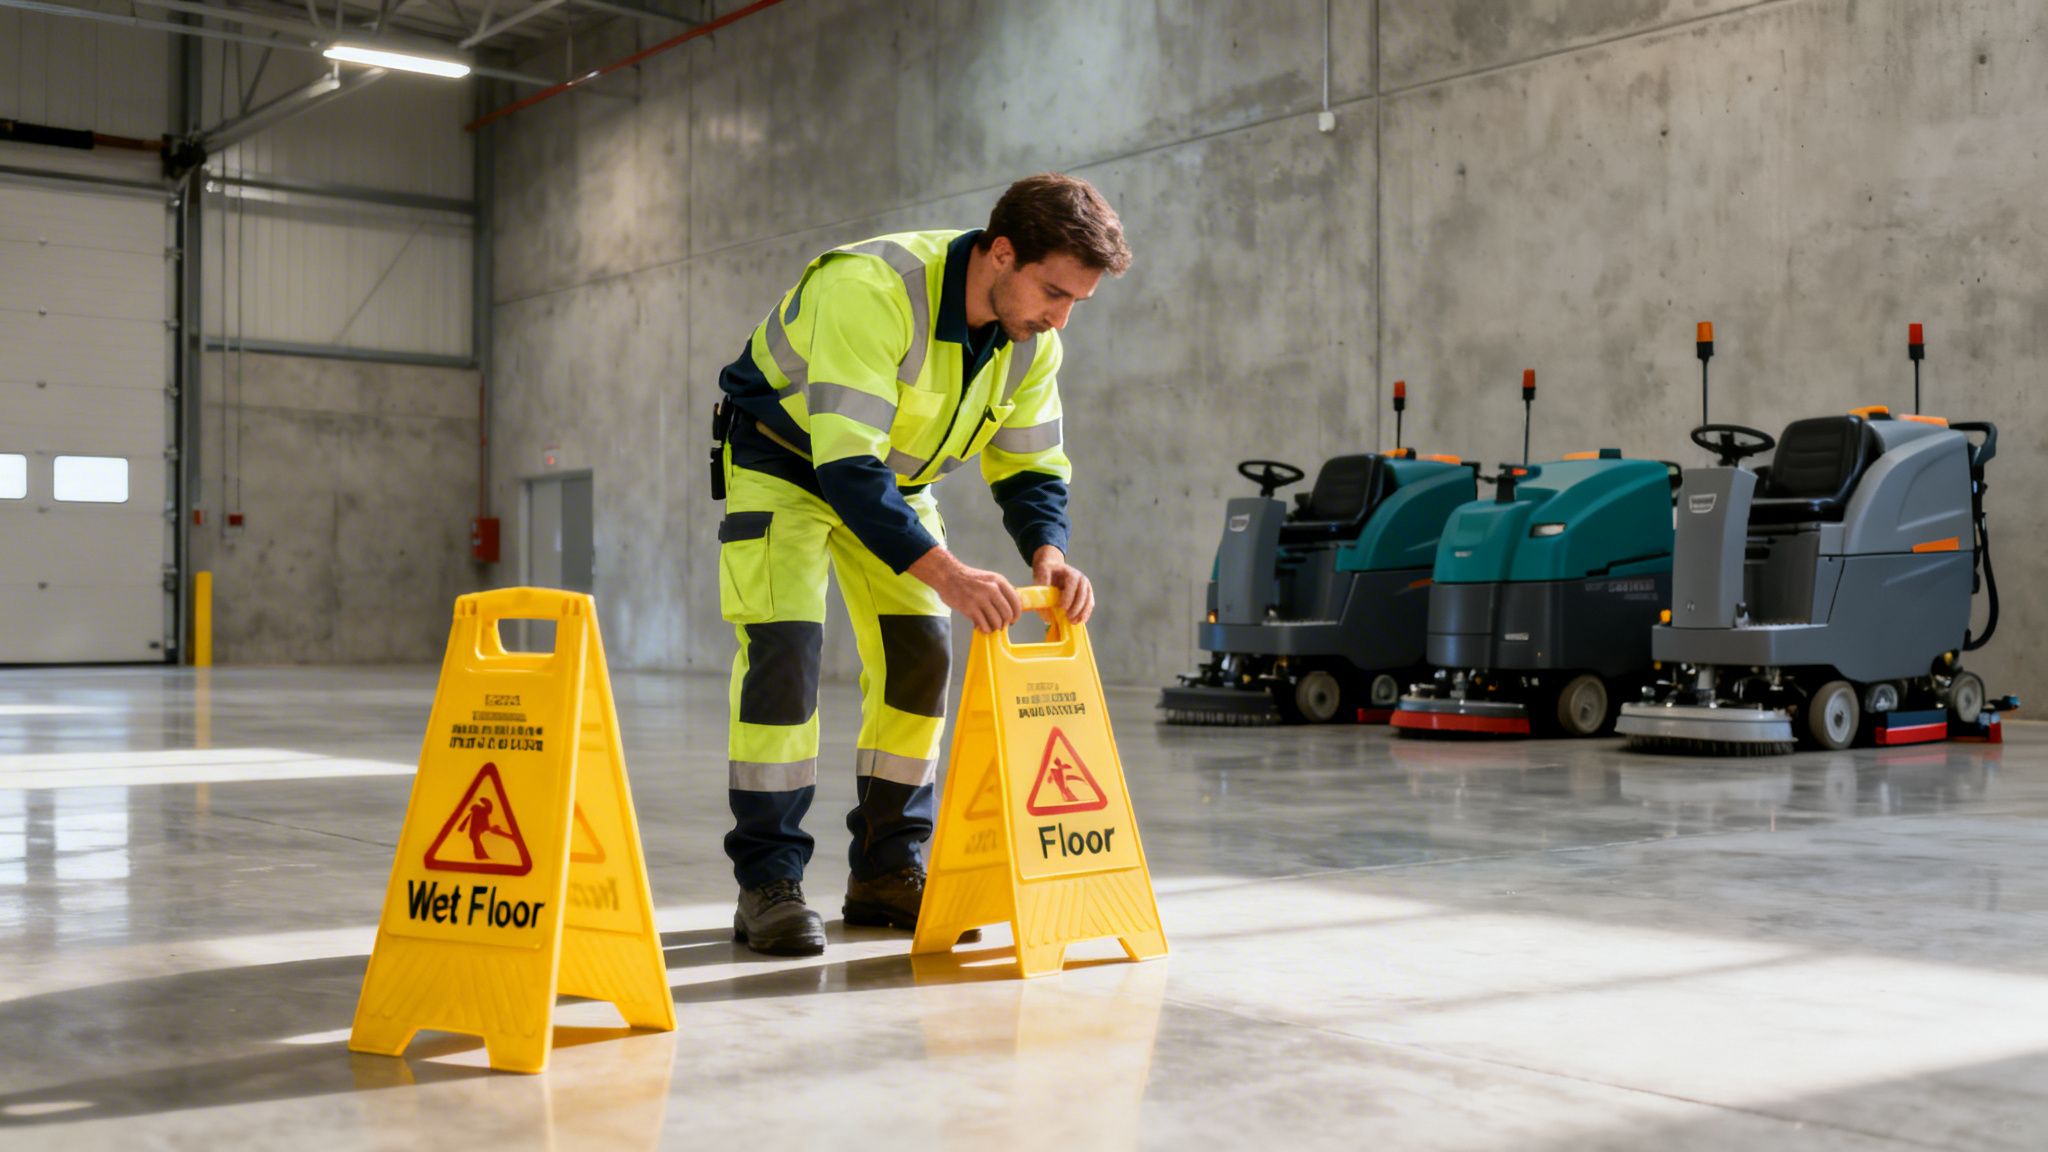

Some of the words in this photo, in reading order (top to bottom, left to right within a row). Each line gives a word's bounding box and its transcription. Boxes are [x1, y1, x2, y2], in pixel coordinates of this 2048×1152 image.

[1038, 822, 1115, 859] Floor
[408, 880, 461, 924] Wet
[467, 886, 545, 928] Floor
